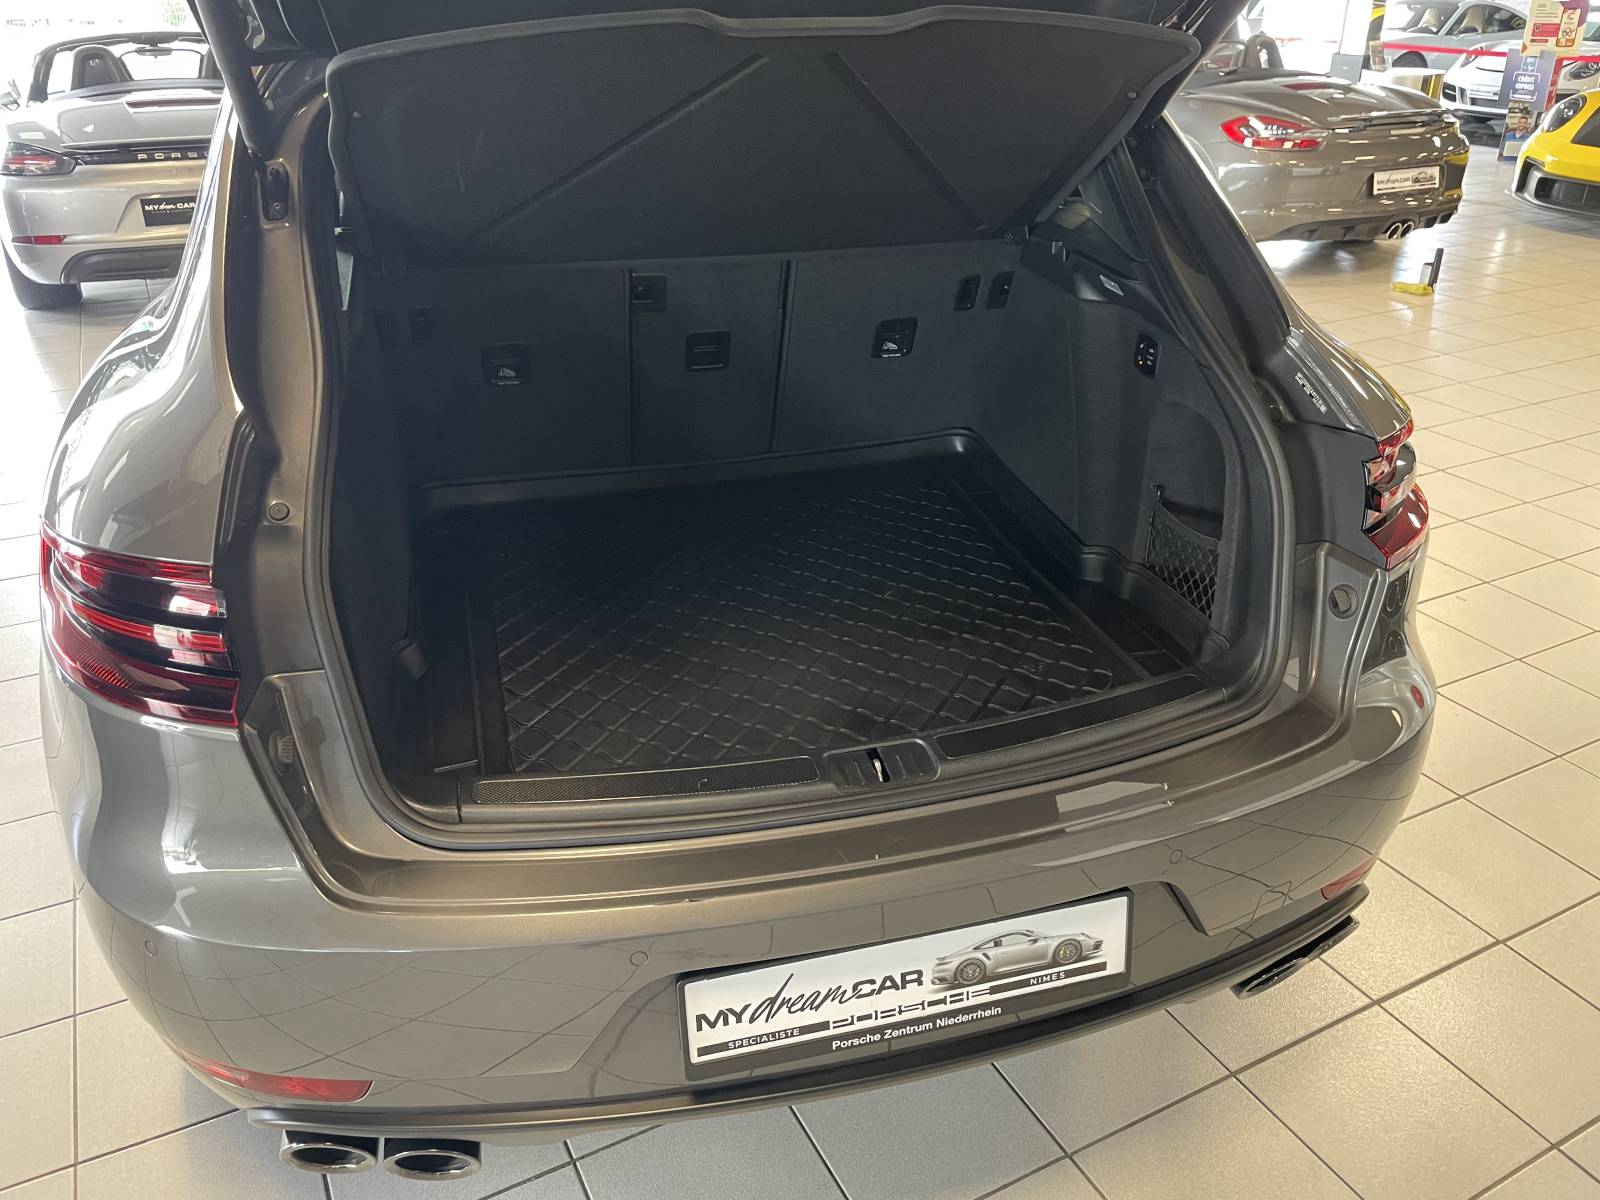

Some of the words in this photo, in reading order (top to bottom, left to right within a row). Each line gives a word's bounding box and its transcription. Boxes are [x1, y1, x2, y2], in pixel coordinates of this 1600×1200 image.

[696, 1003, 751, 1032] MY
[749, 973, 863, 1024] dream
[852, 969, 923, 999] CAR
[728, 1028, 801, 1049] SPECIALISTE
[1029, 971, 1066, 985] NIMES
[832, 1031, 881, 1050] Porsche
[884, 1020, 933, 1039] Zentrum
[936, 1005, 1002, 1028] Niederrhein
